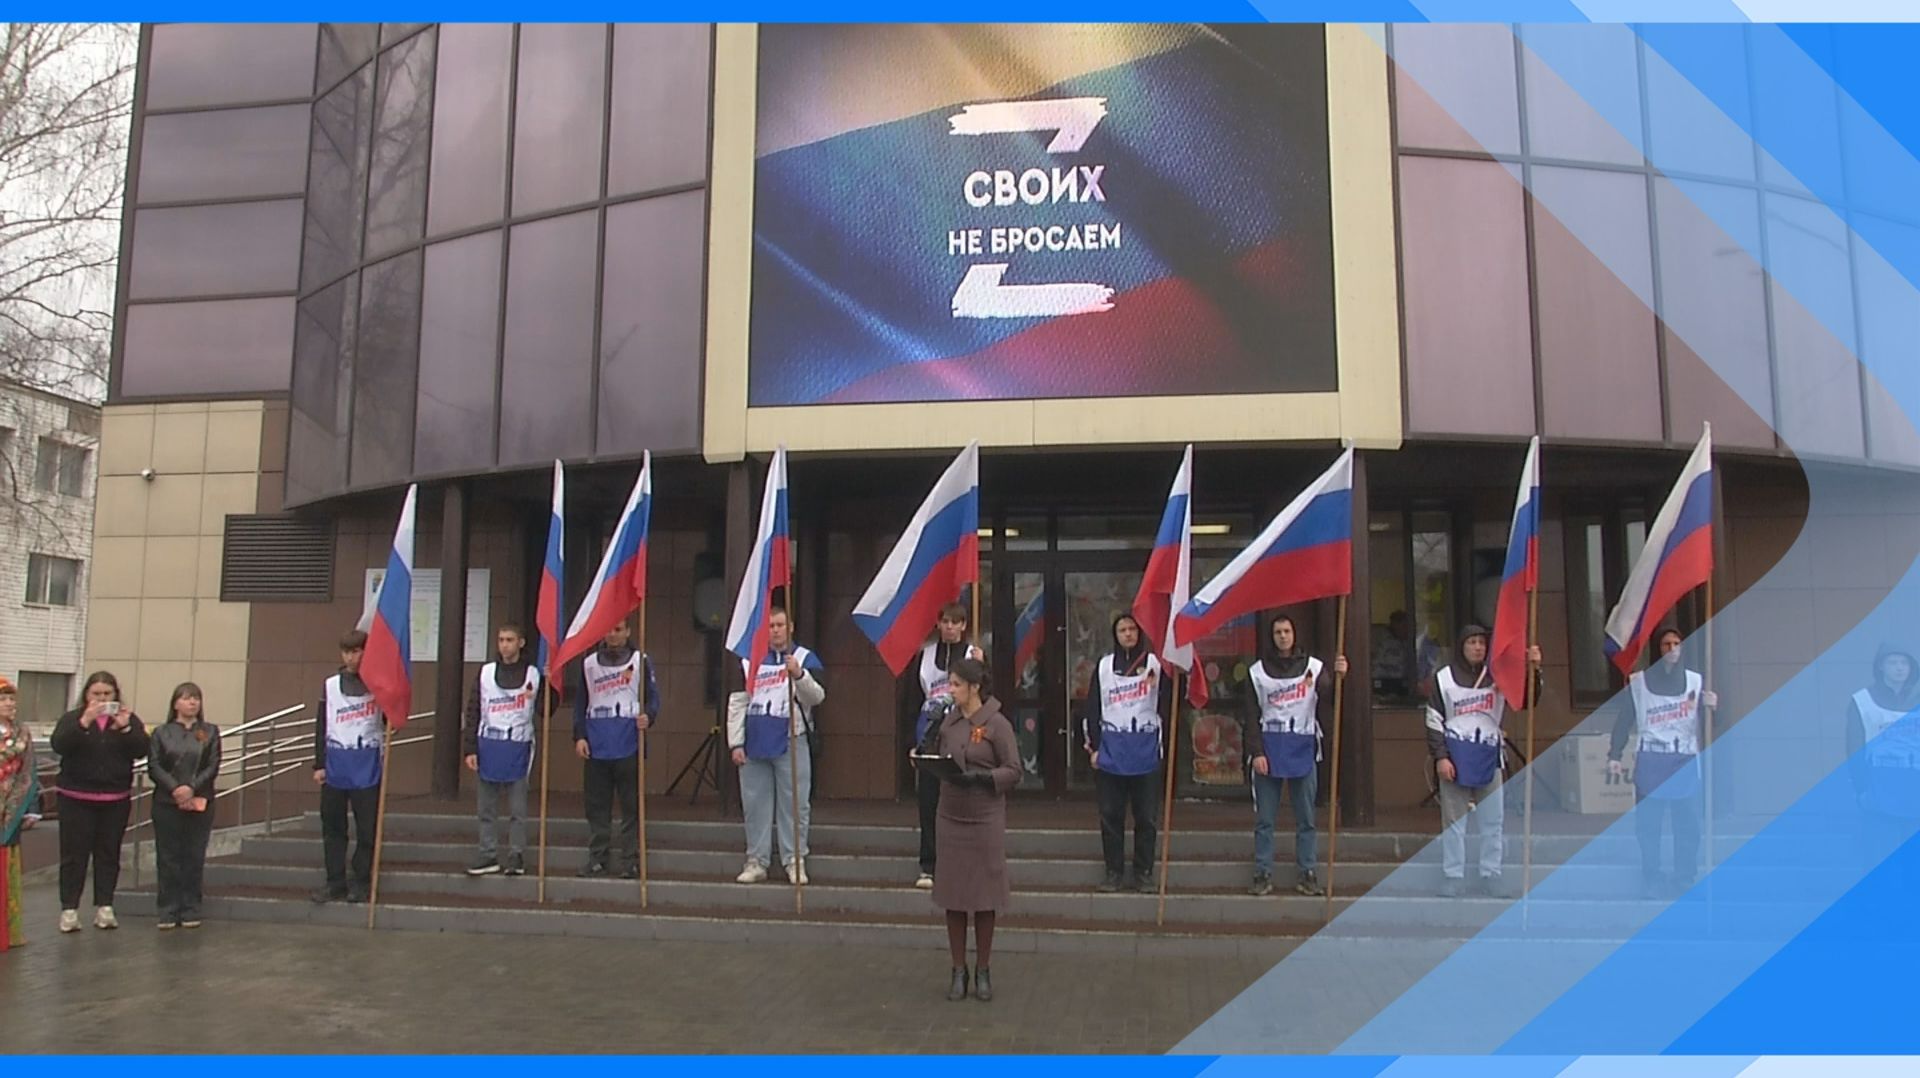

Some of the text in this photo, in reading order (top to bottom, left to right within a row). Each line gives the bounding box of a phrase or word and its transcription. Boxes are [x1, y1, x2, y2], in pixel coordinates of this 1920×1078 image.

[963, 165, 1106, 207] СВОИХ
[949, 222, 1121, 255] НЕ БРОСАЕМ
